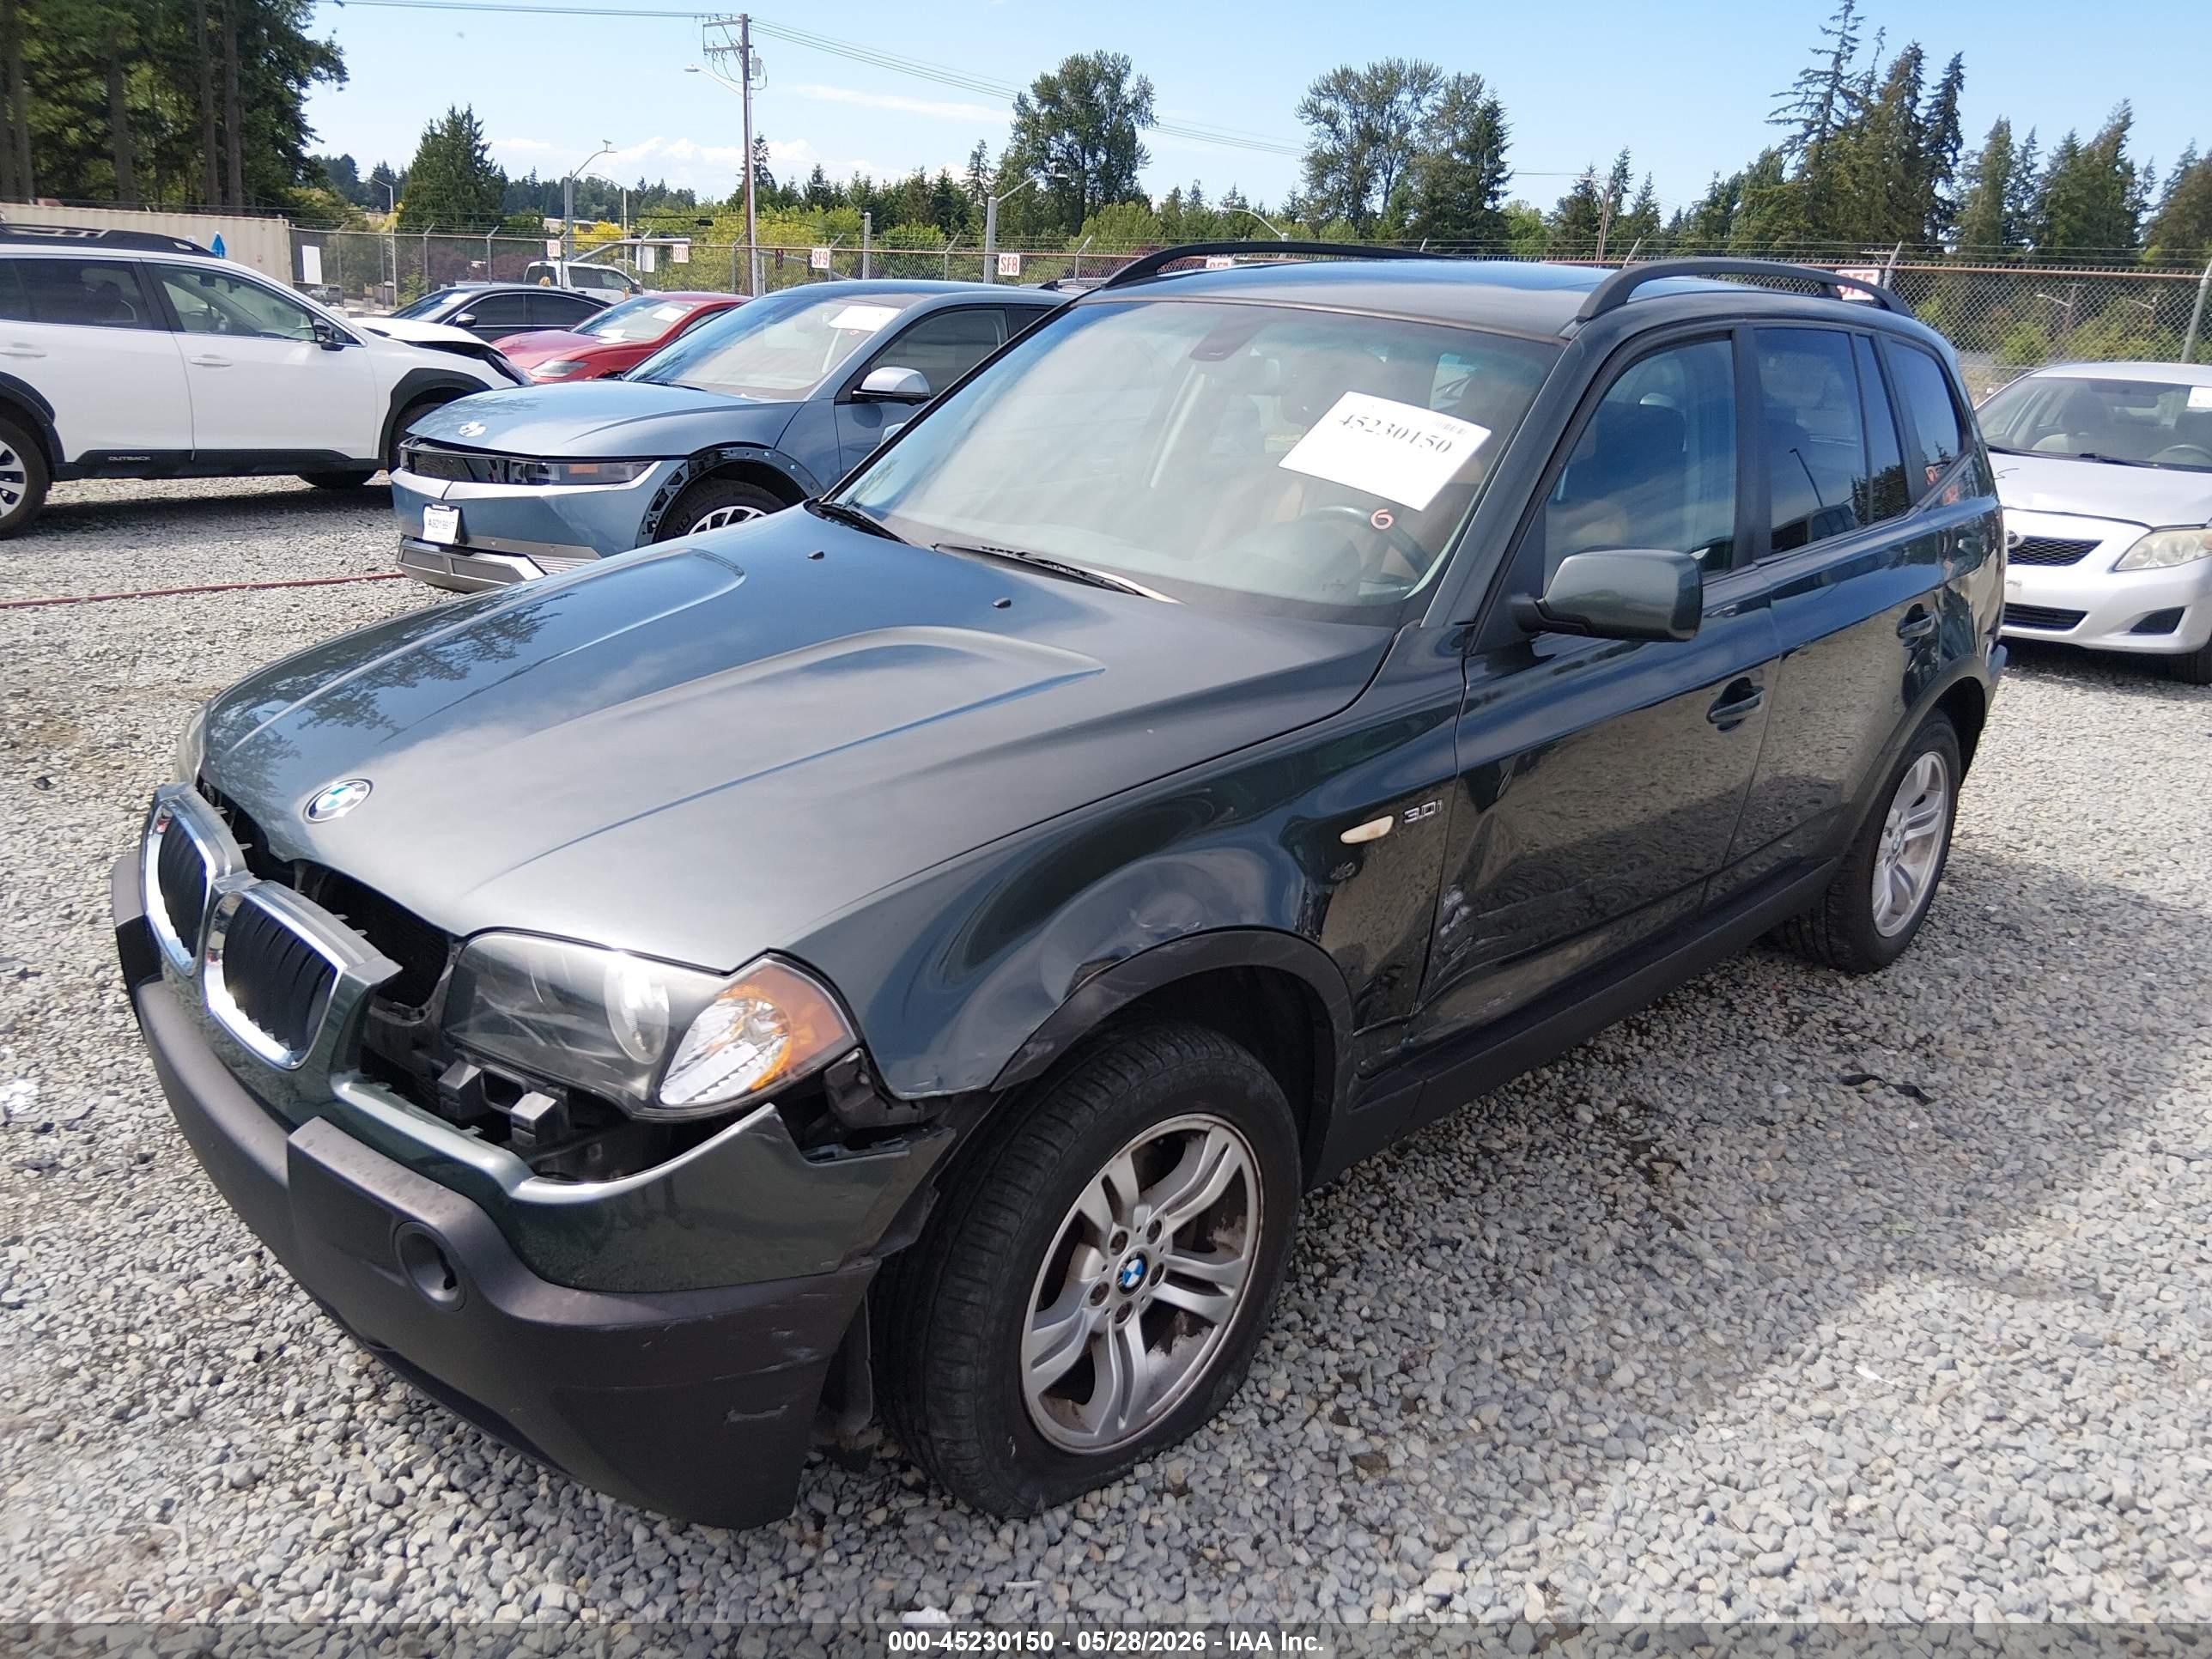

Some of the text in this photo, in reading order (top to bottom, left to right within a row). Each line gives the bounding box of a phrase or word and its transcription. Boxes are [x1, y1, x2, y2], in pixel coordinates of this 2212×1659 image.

[548, 242, 559, 255] SF11
[674, 246, 688, 261] SF10
[813, 251, 829, 266] SF9
[1000, 257, 1018, 273] SF8
[1339, 414, 1453, 454] 45230150
[1403, 799, 1443, 824] 3.0i
